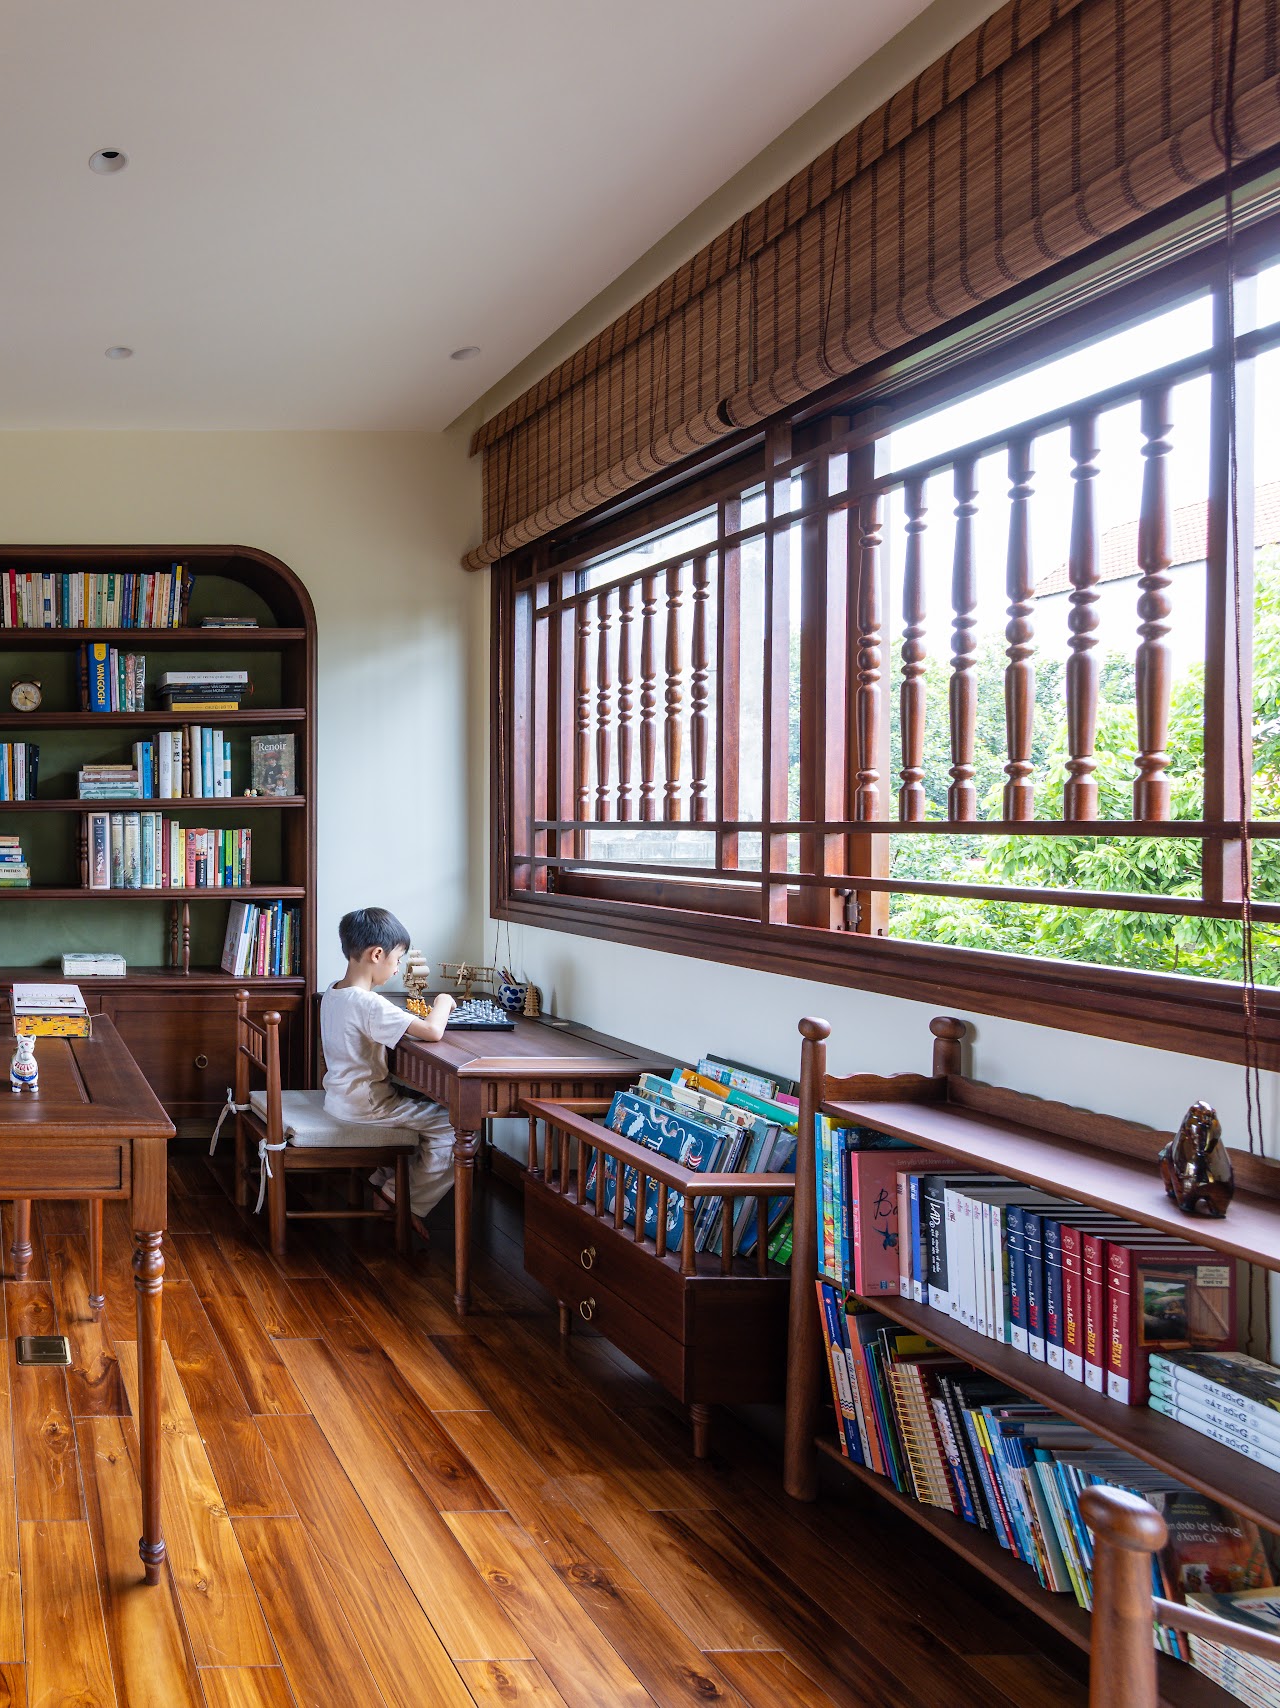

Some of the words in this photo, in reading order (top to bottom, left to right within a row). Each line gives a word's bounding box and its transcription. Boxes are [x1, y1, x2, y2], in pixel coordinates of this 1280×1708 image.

[258, 742, 287, 752] Renoir
[929, 1203, 940, 1224] LAD
[1009, 1235, 1016, 1243] 2
[1027, 1244, 1034, 1252] 1
[1047, 1251, 1054, 1260] 3
[1065, 1258, 1072, 1266] 6
[1086, 1267, 1093, 1276] 5
[1112, 1277, 1120, 1286] 4
[1011, 1295, 1020, 1319] BEAN
[1029, 1305, 1039, 1329] BEAN
[1048, 1313, 1058, 1338] BEAN
[1066, 1321, 1076, 1345] BEAN
[1086, 1331, 1097, 1357] BEAN
[1110, 1342, 1123, 1368] BEAN
[1176, 1521, 1195, 1531] dodo
[1182, 1532, 1203, 1542] Xóm
